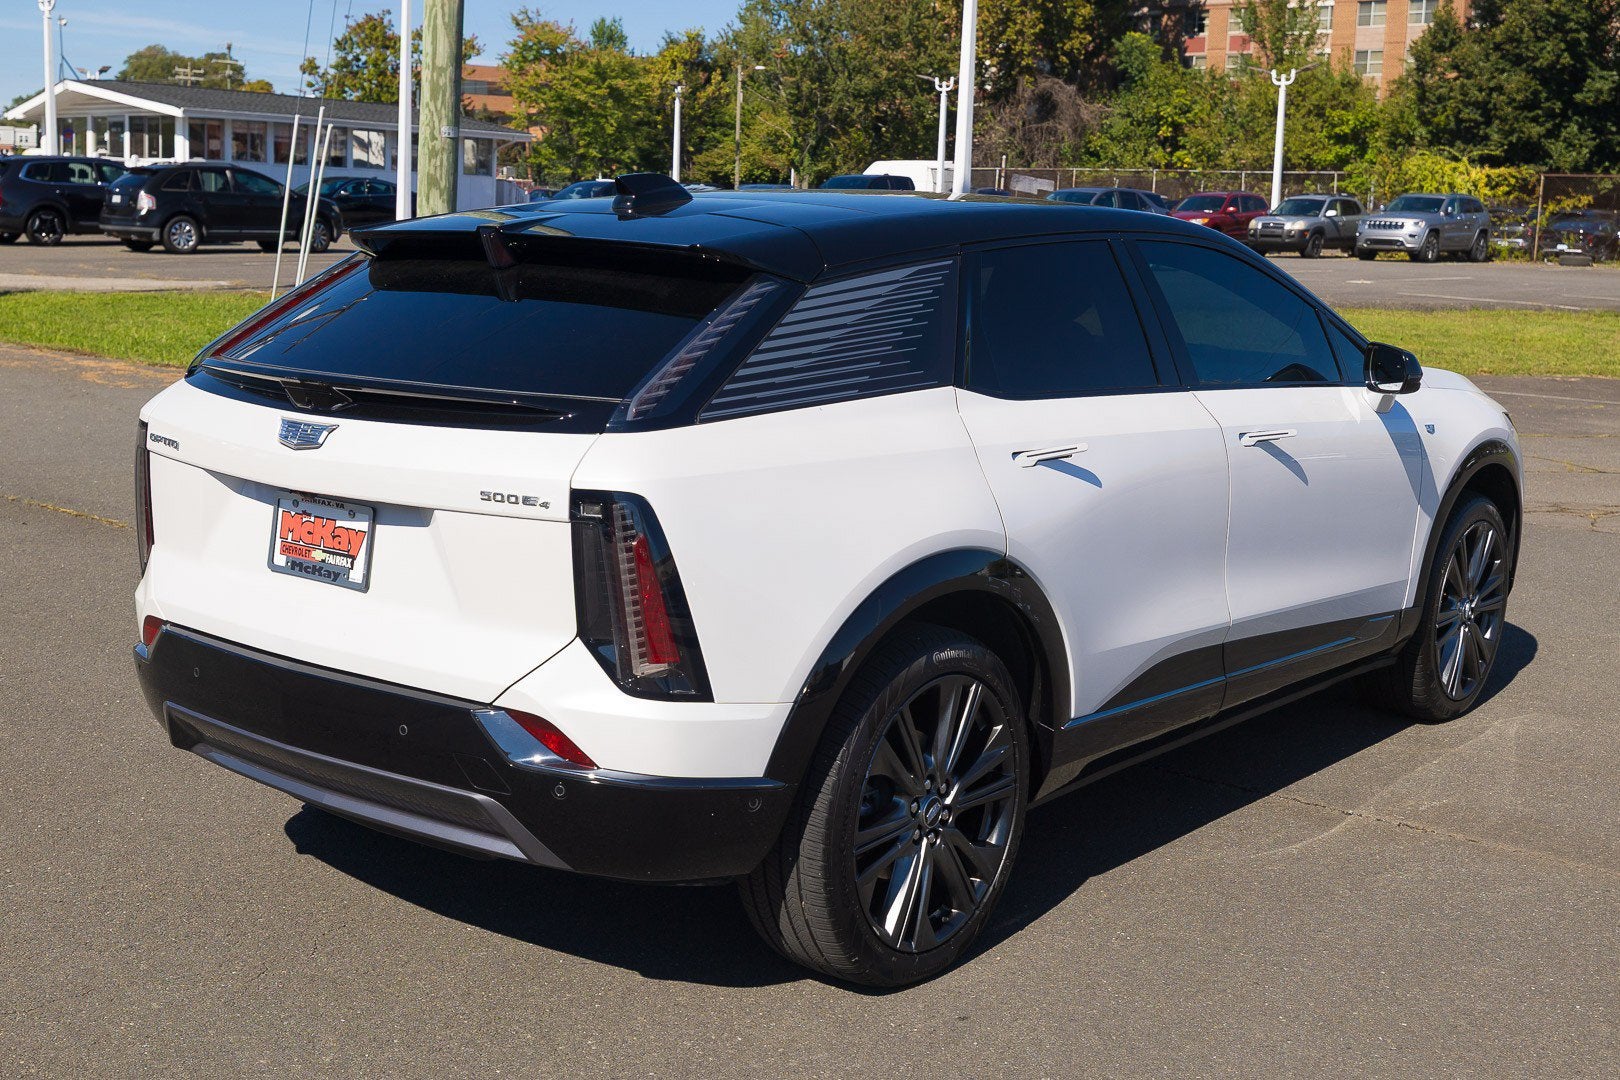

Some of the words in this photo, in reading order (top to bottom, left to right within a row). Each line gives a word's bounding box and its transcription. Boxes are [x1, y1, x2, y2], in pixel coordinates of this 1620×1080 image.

[280, 510, 367, 559] McKay
[281, 544, 312, 559] CHEVROLET
[325, 553, 353, 569] FAIRFAX
[290, 560, 341, 582] McKay
[932, 648, 973, 665] Continental
